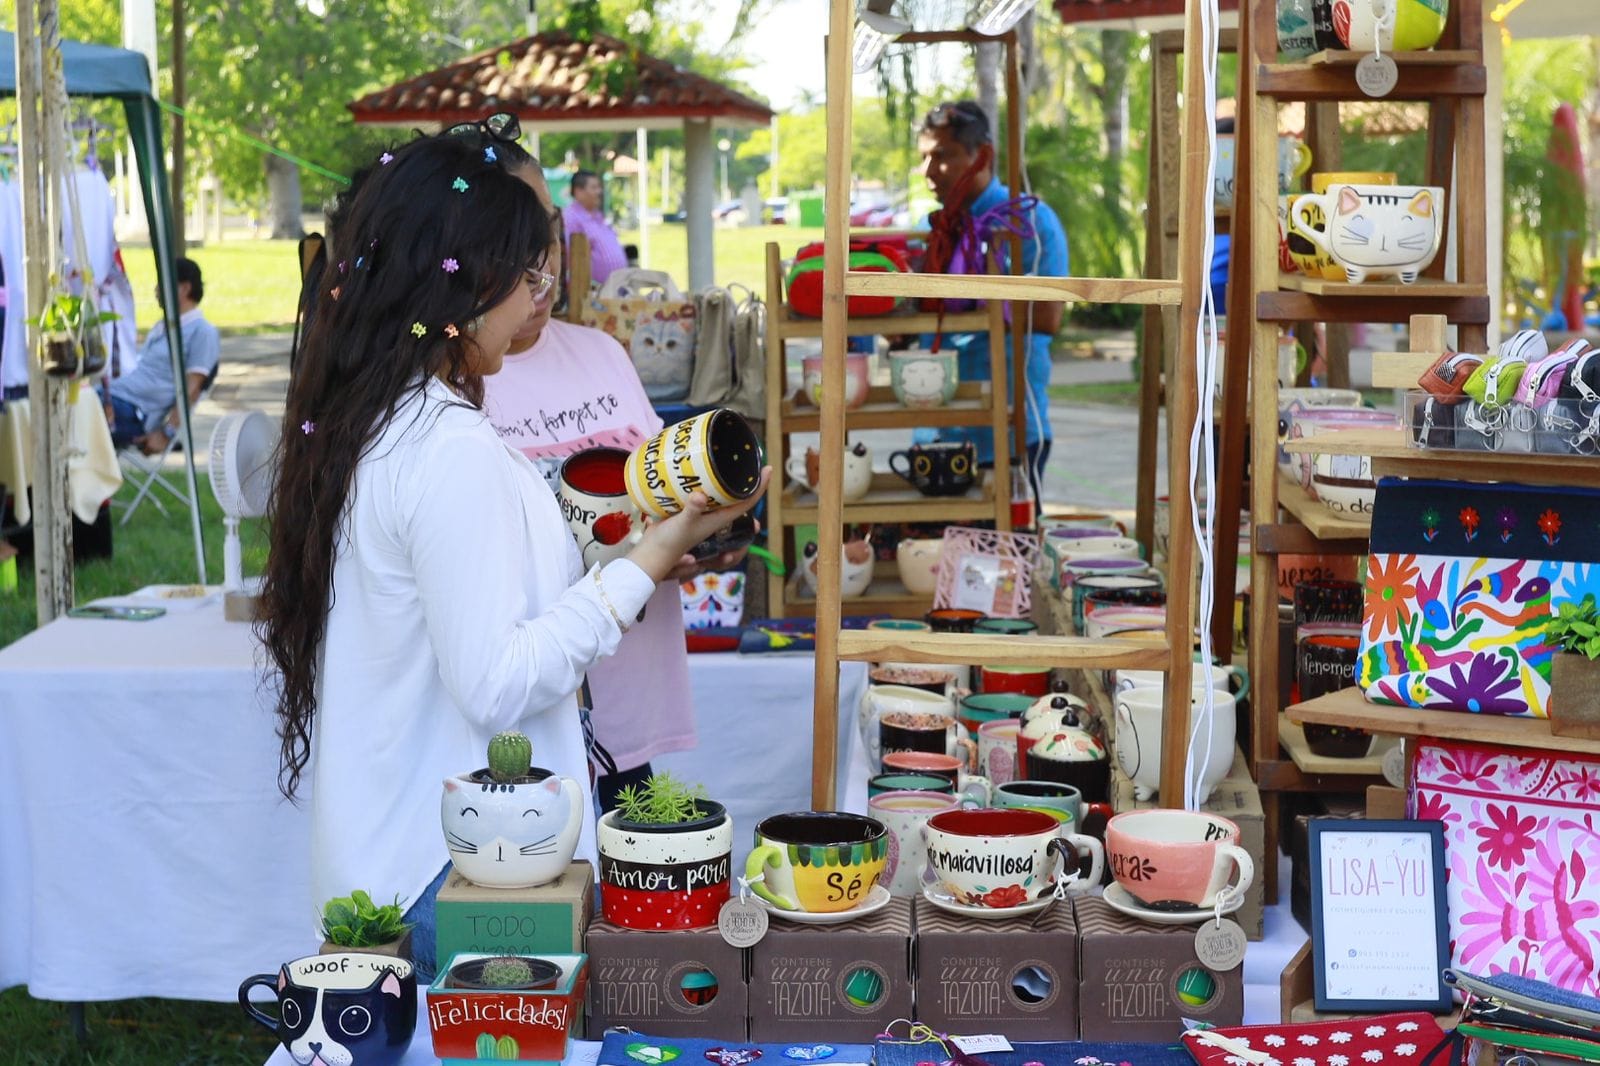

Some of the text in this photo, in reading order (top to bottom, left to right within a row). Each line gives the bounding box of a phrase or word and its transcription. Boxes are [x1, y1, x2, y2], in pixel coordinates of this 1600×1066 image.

[540, 401, 598, 442] forget
[597, 394, 619, 416] to
[608, 860, 678, 891] Amor
[686, 858, 728, 896] para
[939, 850, 1034, 877] maravillosa
[1109, 852, 1143, 882] era
[1328, 855, 1426, 897] LISA-YU
[827, 872, 862, 902] Sé
[464, 914, 537, 938] TODO
[299, 957, 350, 975] woof
[599, 967, 661, 981] una
[600, 957, 660, 968] CONTIENE
[771, 957, 833, 967] CONTIENE
[771, 967, 834, 981] una
[940, 966, 1003, 980] una
[941, 957, 1002, 967] CONTIENE
[1104, 959, 1167, 969] CONTIENE
[1104, 968, 1168, 982] una
[599, 981, 659, 1016] TAZOTA
[771, 981, 831, 1016] TAZOTA
[940, 981, 1001, 1015] TAZOTA
[1104, 983, 1165, 1017] TAZOTA
[430, 996, 568, 1031] ¡Felicidades!
